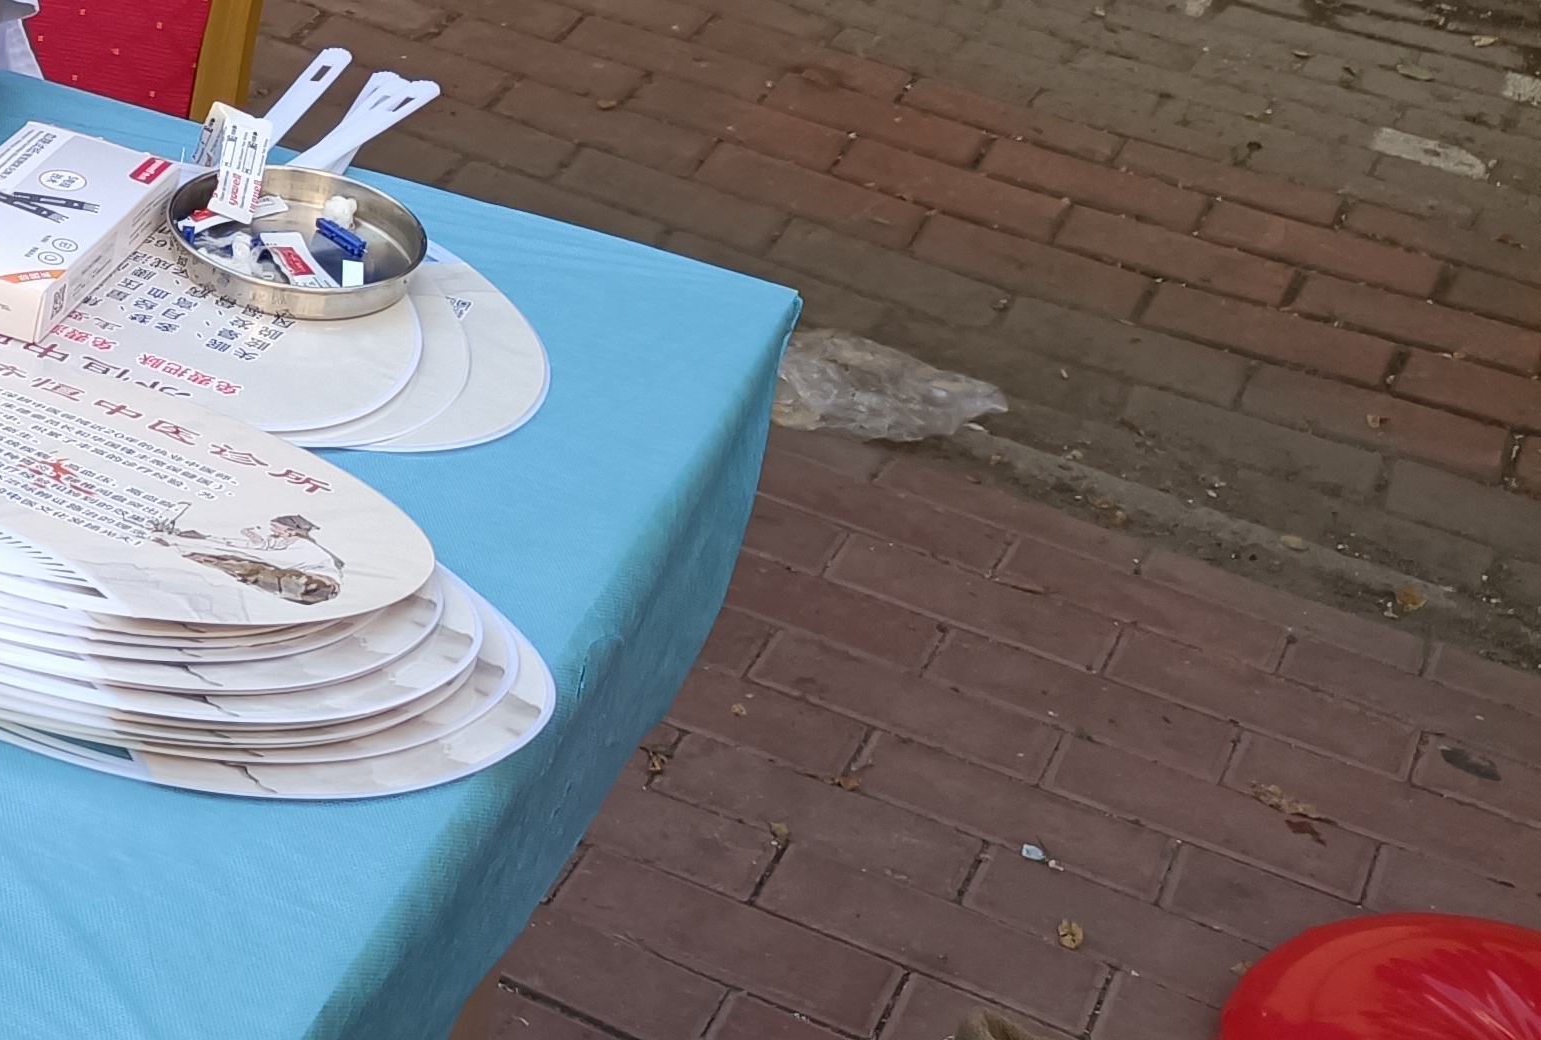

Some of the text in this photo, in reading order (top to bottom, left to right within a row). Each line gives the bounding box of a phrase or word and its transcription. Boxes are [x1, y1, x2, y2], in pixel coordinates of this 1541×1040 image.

[229, 173, 242, 206] yuwell
[137, 353, 241, 396] 免费把脉
